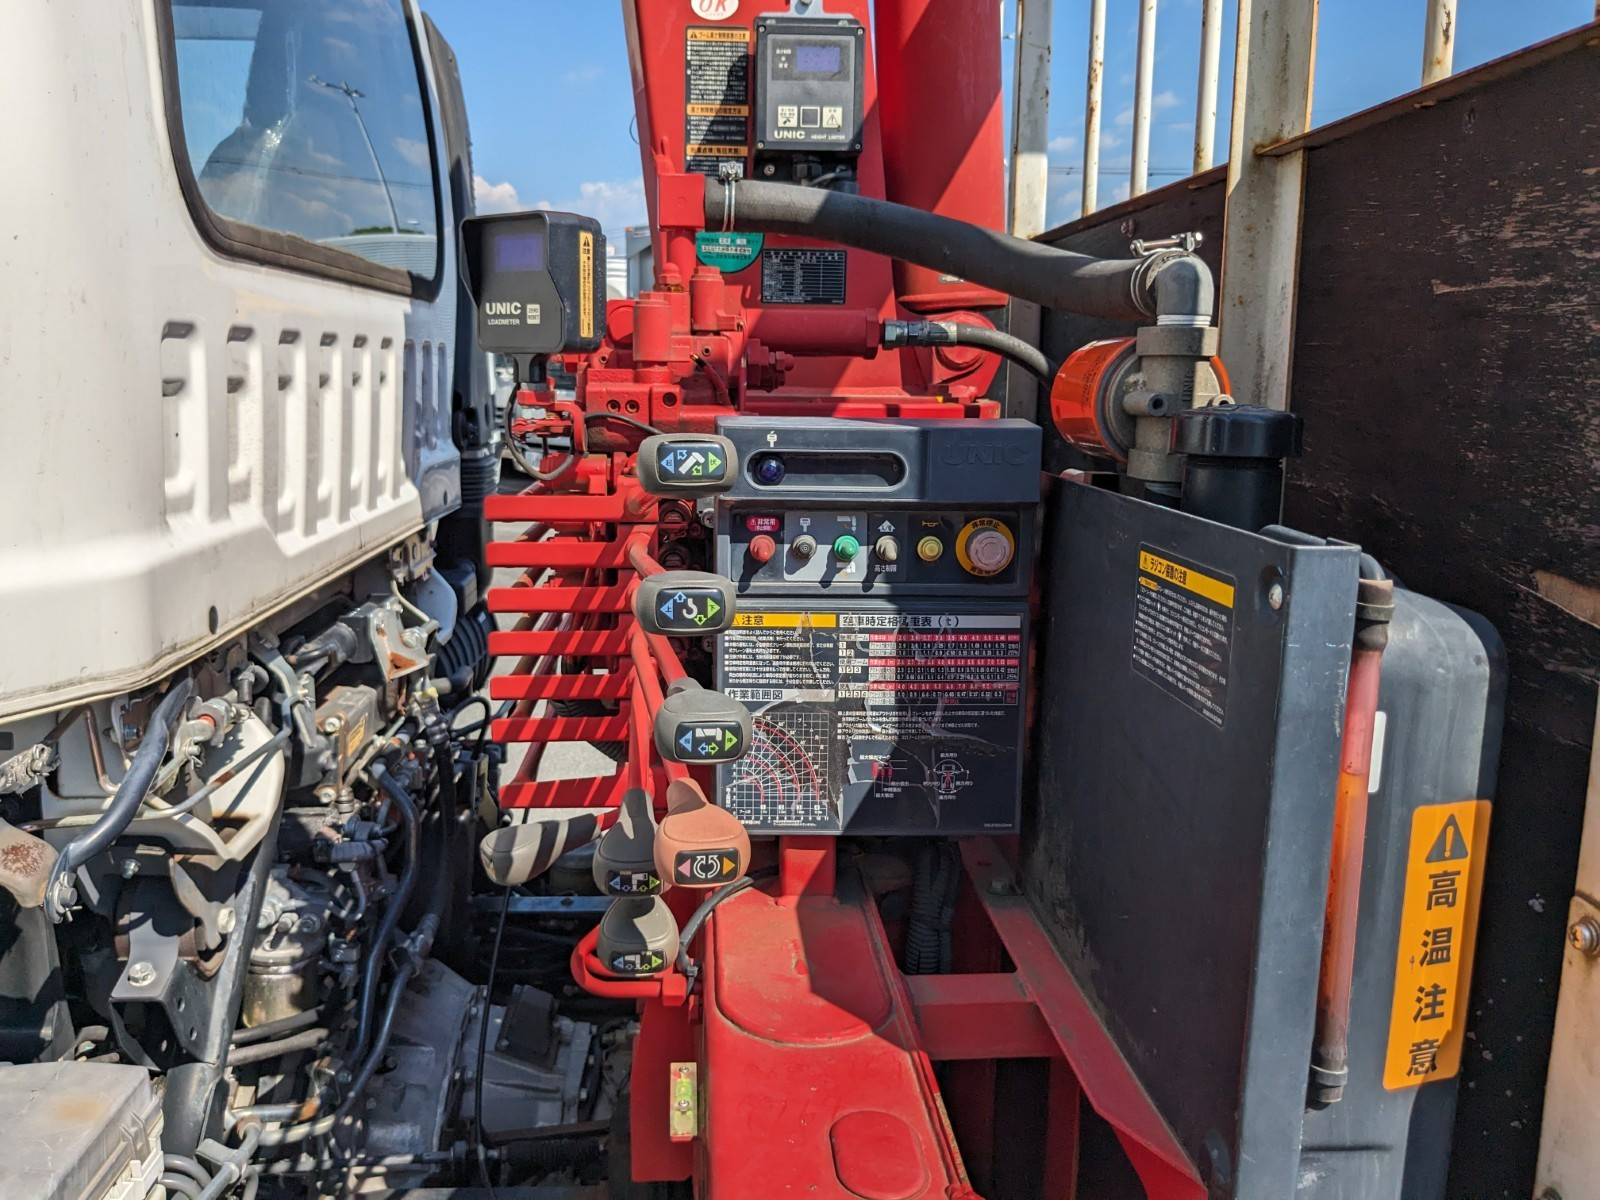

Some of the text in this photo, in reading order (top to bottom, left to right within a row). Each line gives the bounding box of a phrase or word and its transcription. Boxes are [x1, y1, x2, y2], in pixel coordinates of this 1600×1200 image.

[774, 130, 805, 139] UNIC
[486, 302, 521, 315] UNIC
[940, 443, 1032, 467] UNIC
[971, 519, 1001, 529] 非常停止
[874, 564, 897, 573] 高さ制限
[742, 615, 764, 626] 注意
[728, 689, 783, 700] 作業範囲図
[1406, 869, 1461, 1078] 高温注意
